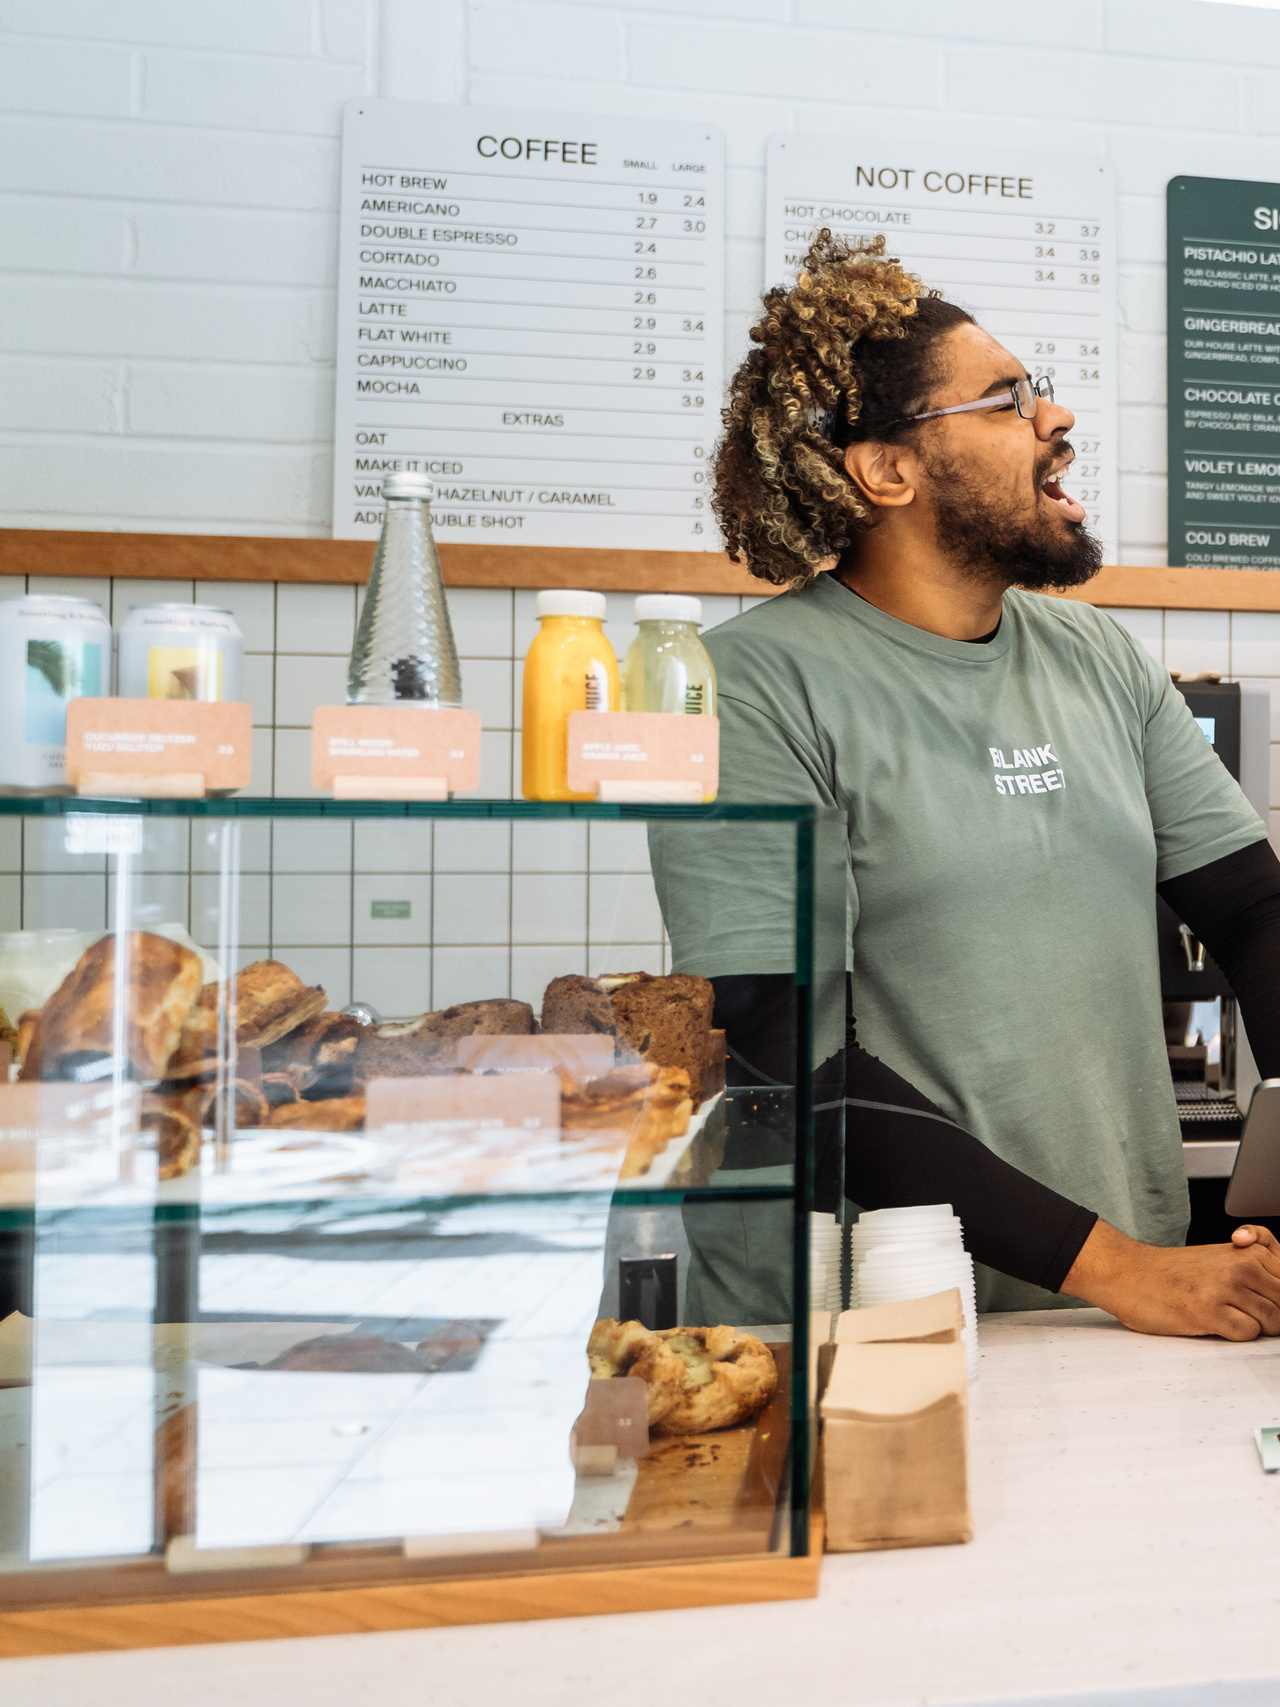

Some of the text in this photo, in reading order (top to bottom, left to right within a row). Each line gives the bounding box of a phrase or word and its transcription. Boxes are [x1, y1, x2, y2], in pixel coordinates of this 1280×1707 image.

[477, 135, 598, 165] COFFEE
[623, 159, 706, 174] SMALL LARGE
[362, 173, 706, 208] HOT BREW 1.9 2.4
[856, 166, 1034, 199] NOT COFFEE
[361, 199, 706, 233] AMERICANO 2.7 3.0
[785, 205, 1100, 238] HOT CHOCOLATE 3.2 3.7
[361, 225, 657, 254] DOUBLE ESPRESSO 2.4
[1034, 246, 1100, 262] 3.4 3.9
[1183, 247, 1257, 264] PISTACHIO
[360, 251, 657, 279] CORTADO 2.6
[1034, 270, 1100, 285] 3.4 3.9
[1184, 268, 1203, 277] OUR
[1205, 270, 1243, 280] CLASSIC
[359, 277, 657, 305] MACCHIATO 2.6
[1184, 278, 1229, 289] PISTACHIO
[359, 302, 704, 332] LATTE 2.9 3.4
[359, 328, 656, 355] FLAT WHITE 2.9
[1035, 342, 1100, 357] 2.9 3.4
[1184, 339, 1203, 349] OUR
[1206, 341, 1236, 350] HOUSE
[1237, 343, 1263, 353] LATTE
[358, 354, 704, 382] CAPPUCCINO 2.9 3.4
[1080, 369, 1100, 380] 3.4
[358, 380, 704, 408] MOCHA 3.9
[1184, 388, 1271, 405] CHOCOLATE
[503, 412, 564, 427] EXTRAS
[1185, 410, 1230, 420] ESPRESSO
[1232, 413, 1250, 422] AND
[1185, 420, 1197, 429] BY
[1199, 421, 1251, 432] CHOCOLATE
[356, 432, 703, 459] OAT 0
[1081, 442, 1100, 452] 2.7
[355, 458, 463, 475] MAKE IT ICED
[1081, 466, 1100, 476] 2.7
[1184, 460, 1235, 475] VIOLET
[1081, 490, 1100, 501] 2.7
[1185, 481, 1214, 491] TANGY
[1216, 484, 1265, 494] LEMONADE
[438, 487, 524, 503] HAZELNUT
[539, 491, 616, 507] CARAMEL
[1185, 492, 1267, 503] AND SWEET VIOLET
[482, 515, 526, 529] SHOT
[1185, 532, 1226, 545] COLD
[1229, 534, 1270, 547] BREW
[1186, 554, 1211, 562] COLD
[1213, 555, 1249, 564] BREWED
[685, 684, 703, 714] UICE
[989, 744, 1058, 769] BLANK
[994, 769, 1066, 795] STREET
